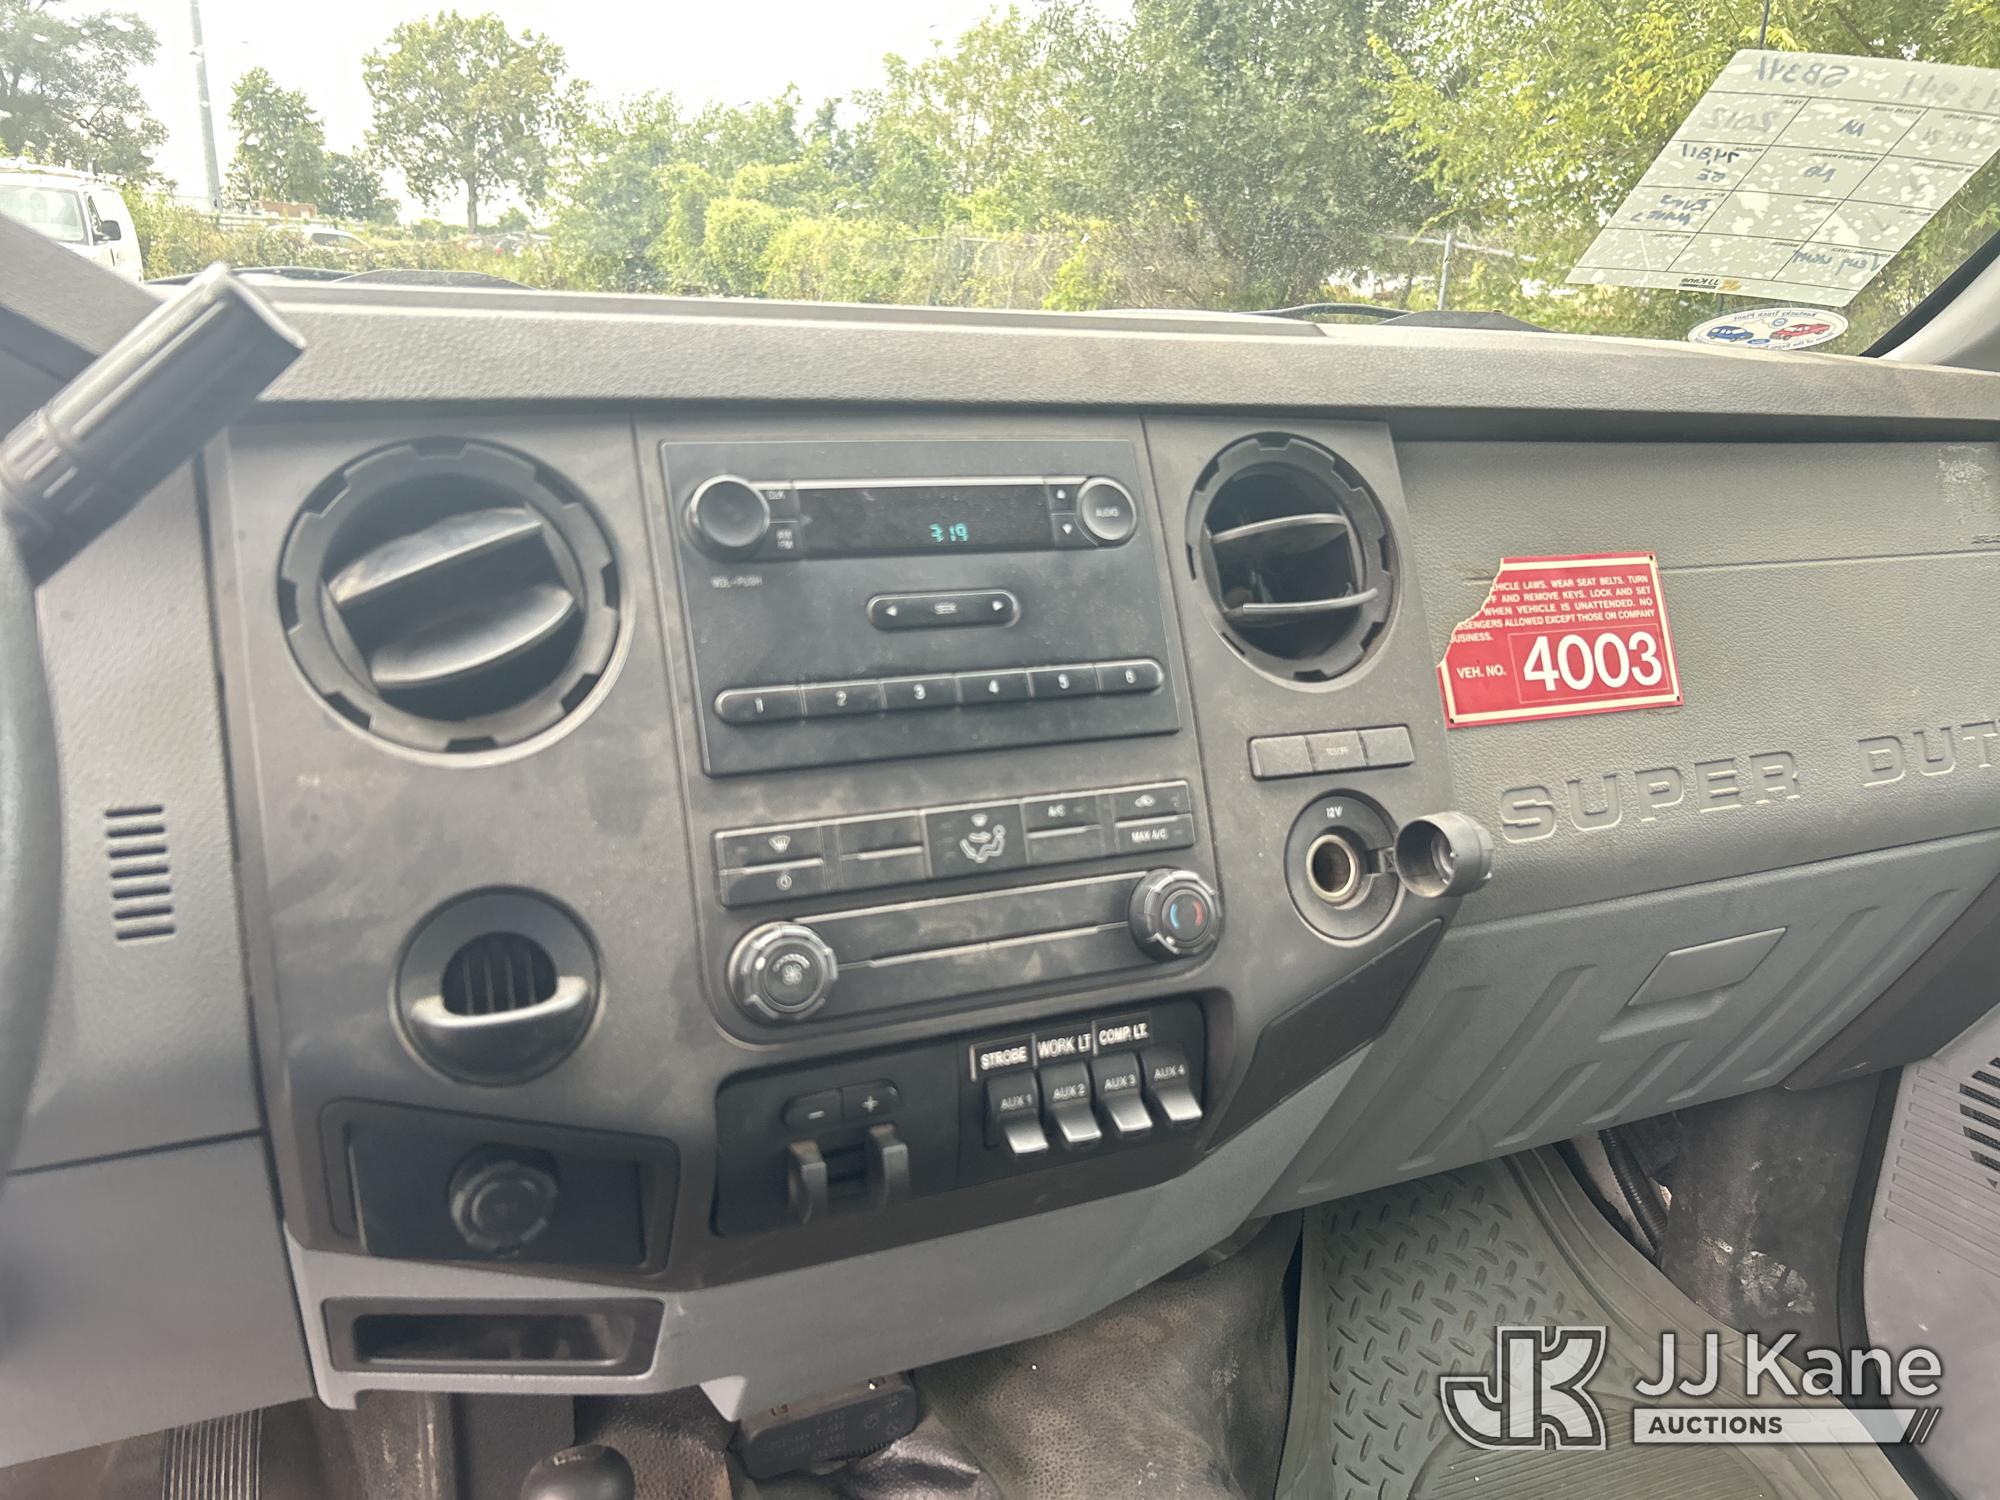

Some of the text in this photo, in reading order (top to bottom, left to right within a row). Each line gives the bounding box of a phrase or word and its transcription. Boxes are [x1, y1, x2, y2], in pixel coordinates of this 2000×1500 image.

[1523, 580, 1547, 590] LAWS.
[1551, 578, 1575, 589] WEAR
[1577, 577, 1597, 587] SEAT
[1600, 575, 1626, 586] BELTS.
[1628, 574, 1649, 584] TURN
[1501, 594, 1520, 604] AND
[1524, 591, 1559, 602] REMOVE
[1563, 589, 1587, 600] KEYS.
[1590, 587, 1613, 598] LOCK
[1616, 586, 1634, 597] AND
[1636, 585, 1651, 595] SET
[1484, 596, 1654, 617] WHEN VEHICLE IS UNATTENDED. NO
[1505, 615, 1545, 628] ALLOWED
[1545, 613, 1575, 626] EXCEPT
[1577, 611, 1605, 623] THOSE
[1605, 610, 1617, 620] ON
[1618, 608, 1656, 620] COMPANY
[1523, 630, 1663, 692] 4003
[1456, 663, 1507, 680] VEH. NO.
[754, 669, 1136, 713] 1 2 3 4 5 6
[1500, 719, 2000, 844] SUPER DUT
[1326, 806, 1343, 818] 12V
[1037, 1033, 1091, 1059] WORK LT
[980, 1045, 1028, 1070] STROBE
[1104, 1073, 1137, 1090] AUX 3
[1154, 1064, 1185, 1080] AUX 4
[1053, 1083, 1086, 1099] AUX 2
[1001, 1093, 1032, 1110] AUX 1
